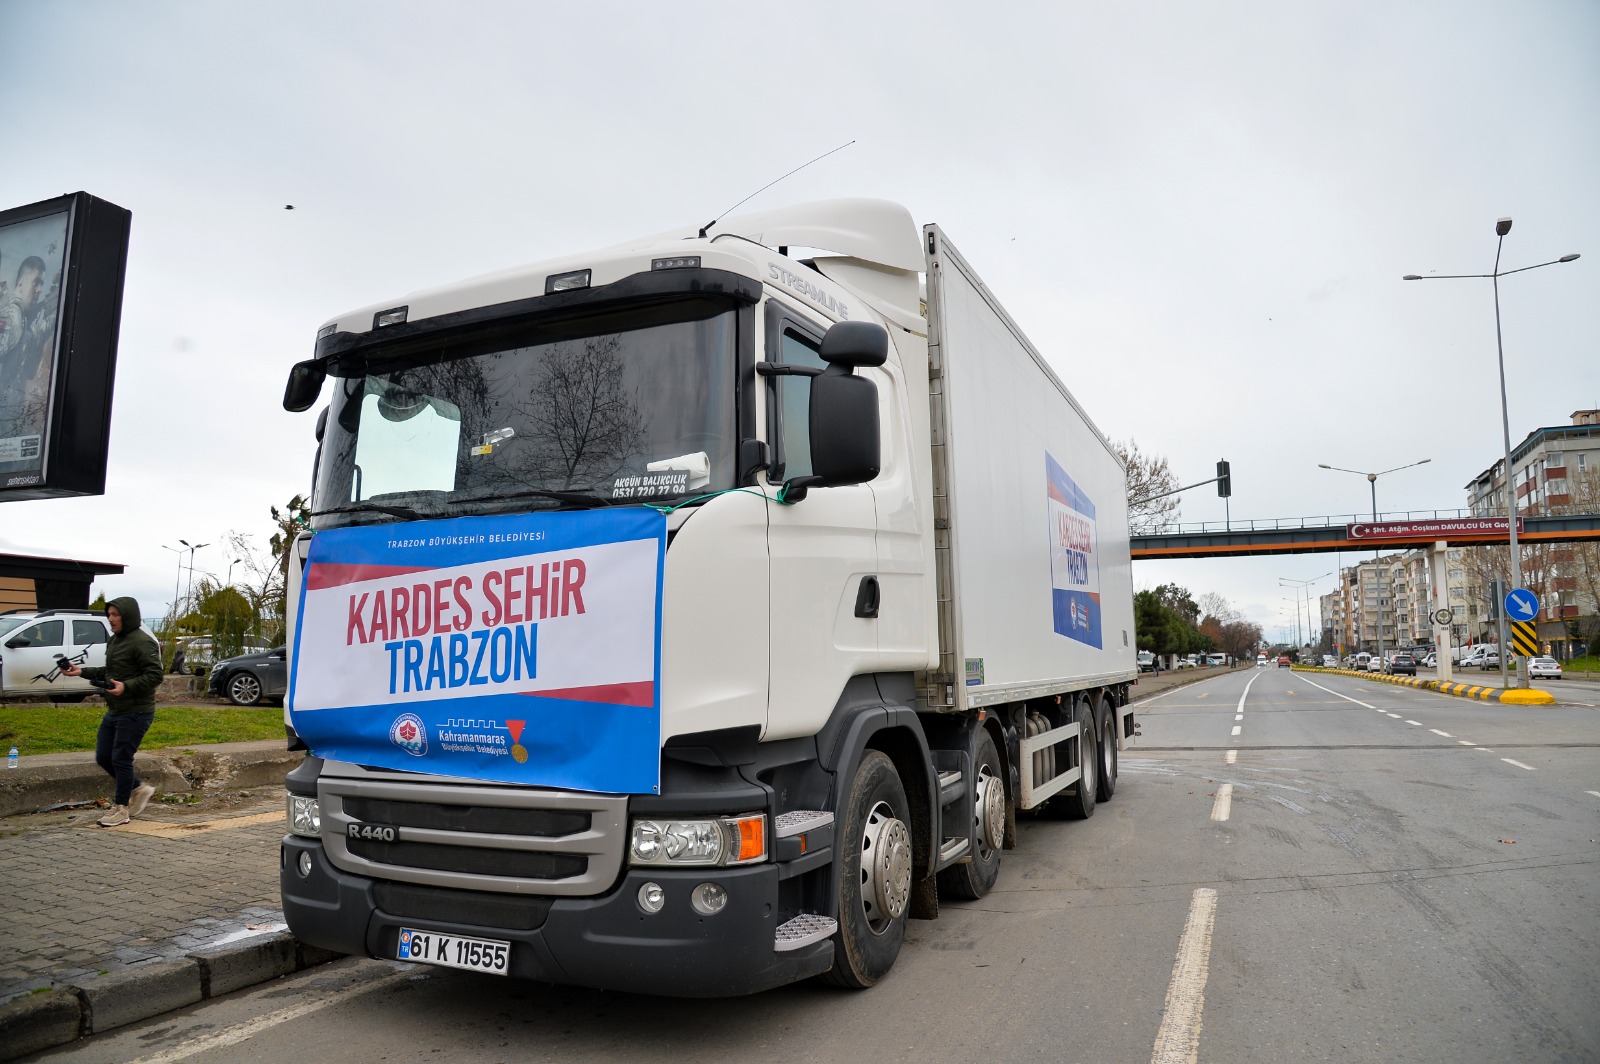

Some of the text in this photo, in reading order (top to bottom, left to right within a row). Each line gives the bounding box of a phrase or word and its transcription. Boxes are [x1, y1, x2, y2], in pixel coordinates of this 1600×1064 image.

[768, 261, 848, 320] STREAMLINE
[614, 475, 641, 488] AKGÜN
[612, 487, 634, 498] 0531
[1413, 524, 1439, 533] Coşkun
[1441, 522, 1478, 530] DAVULCU
[1479, 520, 1492, 529] Üst
[1494, 520, 1520, 529] Geçi
[387, 530, 545, 549] TRABZON BÜYÜKŞEHİR BELEDİYESİ
[347, 558, 586, 646] KARDEŞ ŞEHİR
[384, 623, 538, 695] TRABZON
[439, 730, 505, 745] Kahramanmaraş
[476, 745, 508, 756] Belediyesi
[402, 945, 409, 953] TR
[411, 934, 507, 969] 61 K 11555
